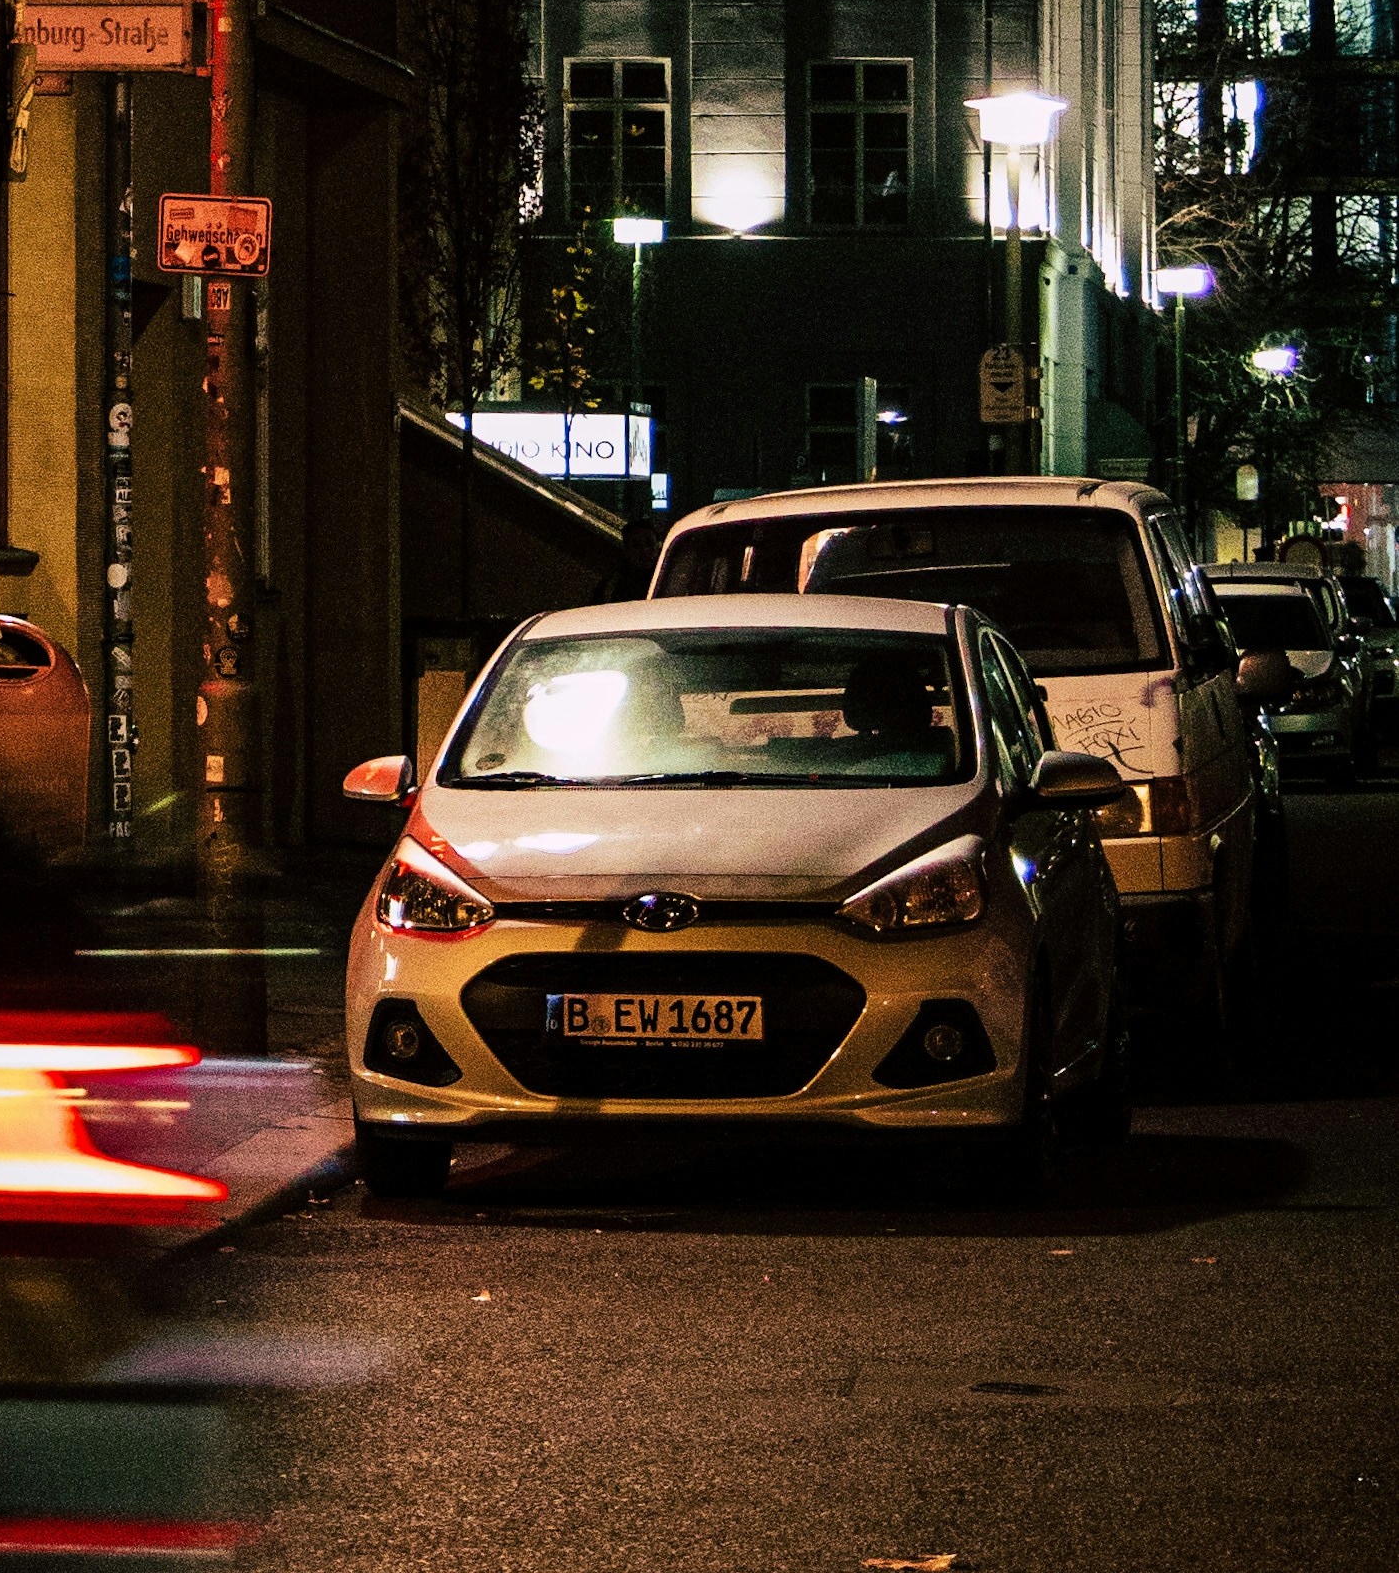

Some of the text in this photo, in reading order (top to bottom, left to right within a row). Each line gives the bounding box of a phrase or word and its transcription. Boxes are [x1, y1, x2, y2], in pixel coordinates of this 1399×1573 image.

[568, 999, 757, 1034] B EW 1687
